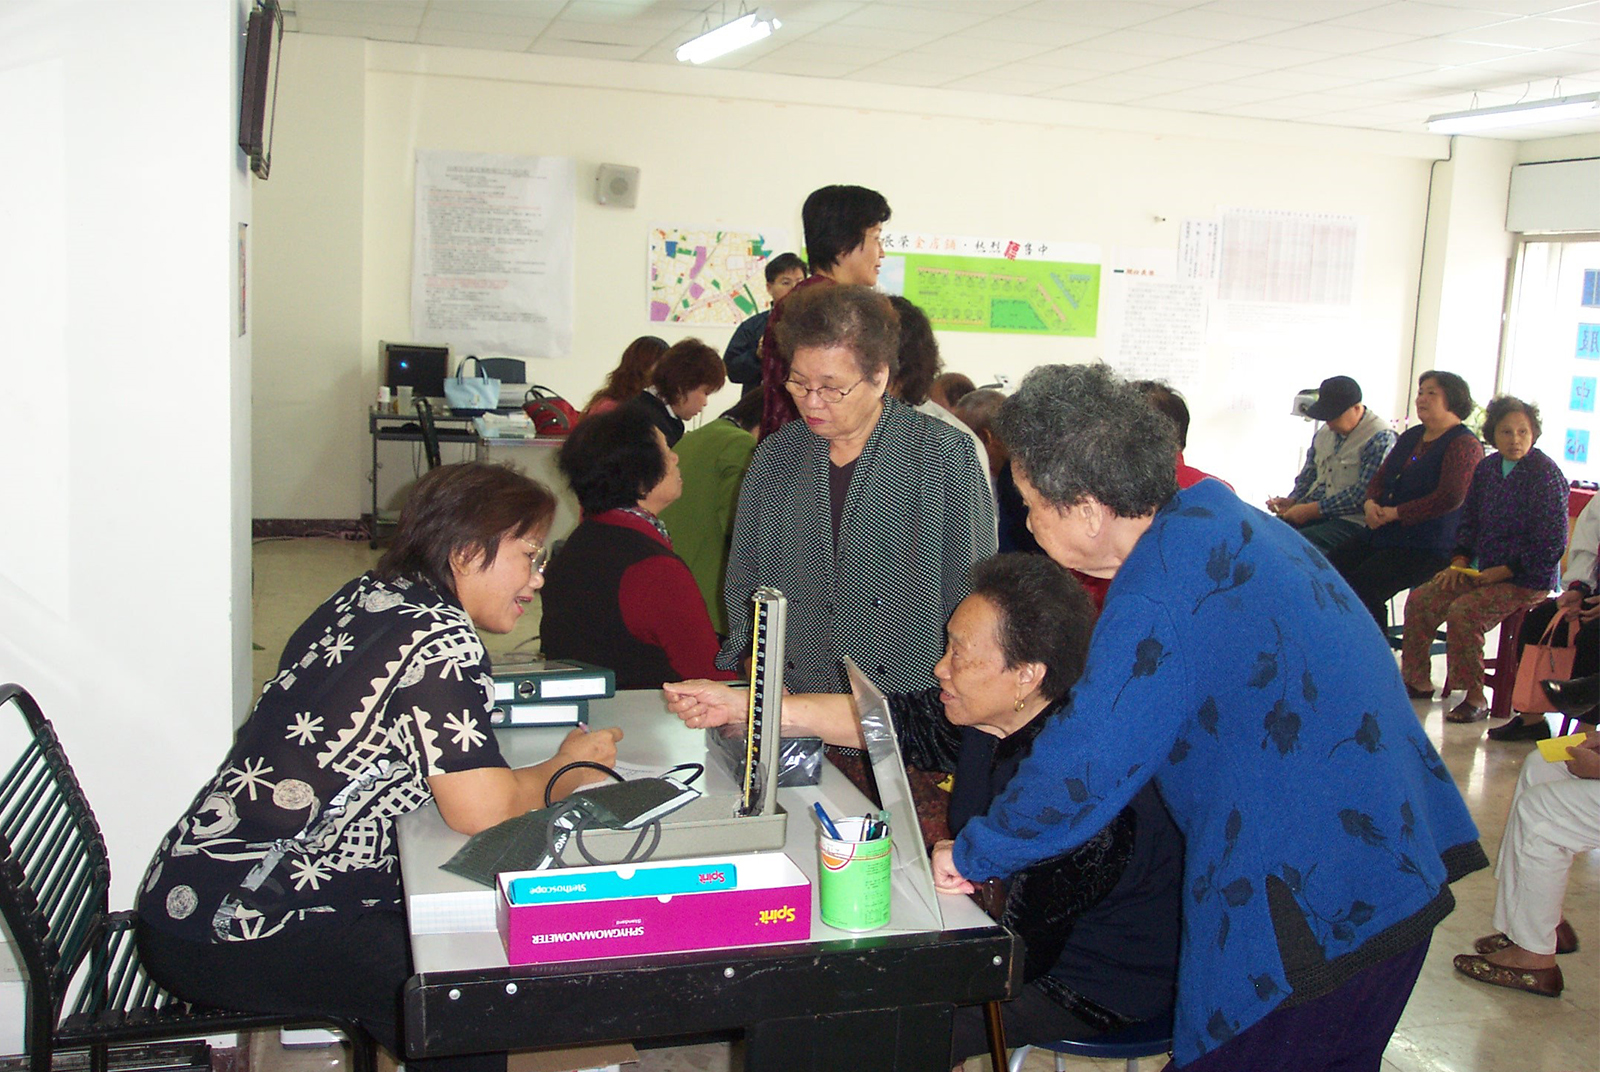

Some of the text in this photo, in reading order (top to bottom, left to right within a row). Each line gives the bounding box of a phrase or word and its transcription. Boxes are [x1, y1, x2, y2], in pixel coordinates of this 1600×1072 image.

[698, 870, 725, 883] Spirit
[529, 883, 587, 895] Stethoscope
[759, 905, 796, 924] Spirit
[532, 926, 644, 945] SPHYGMOMANOMETER
